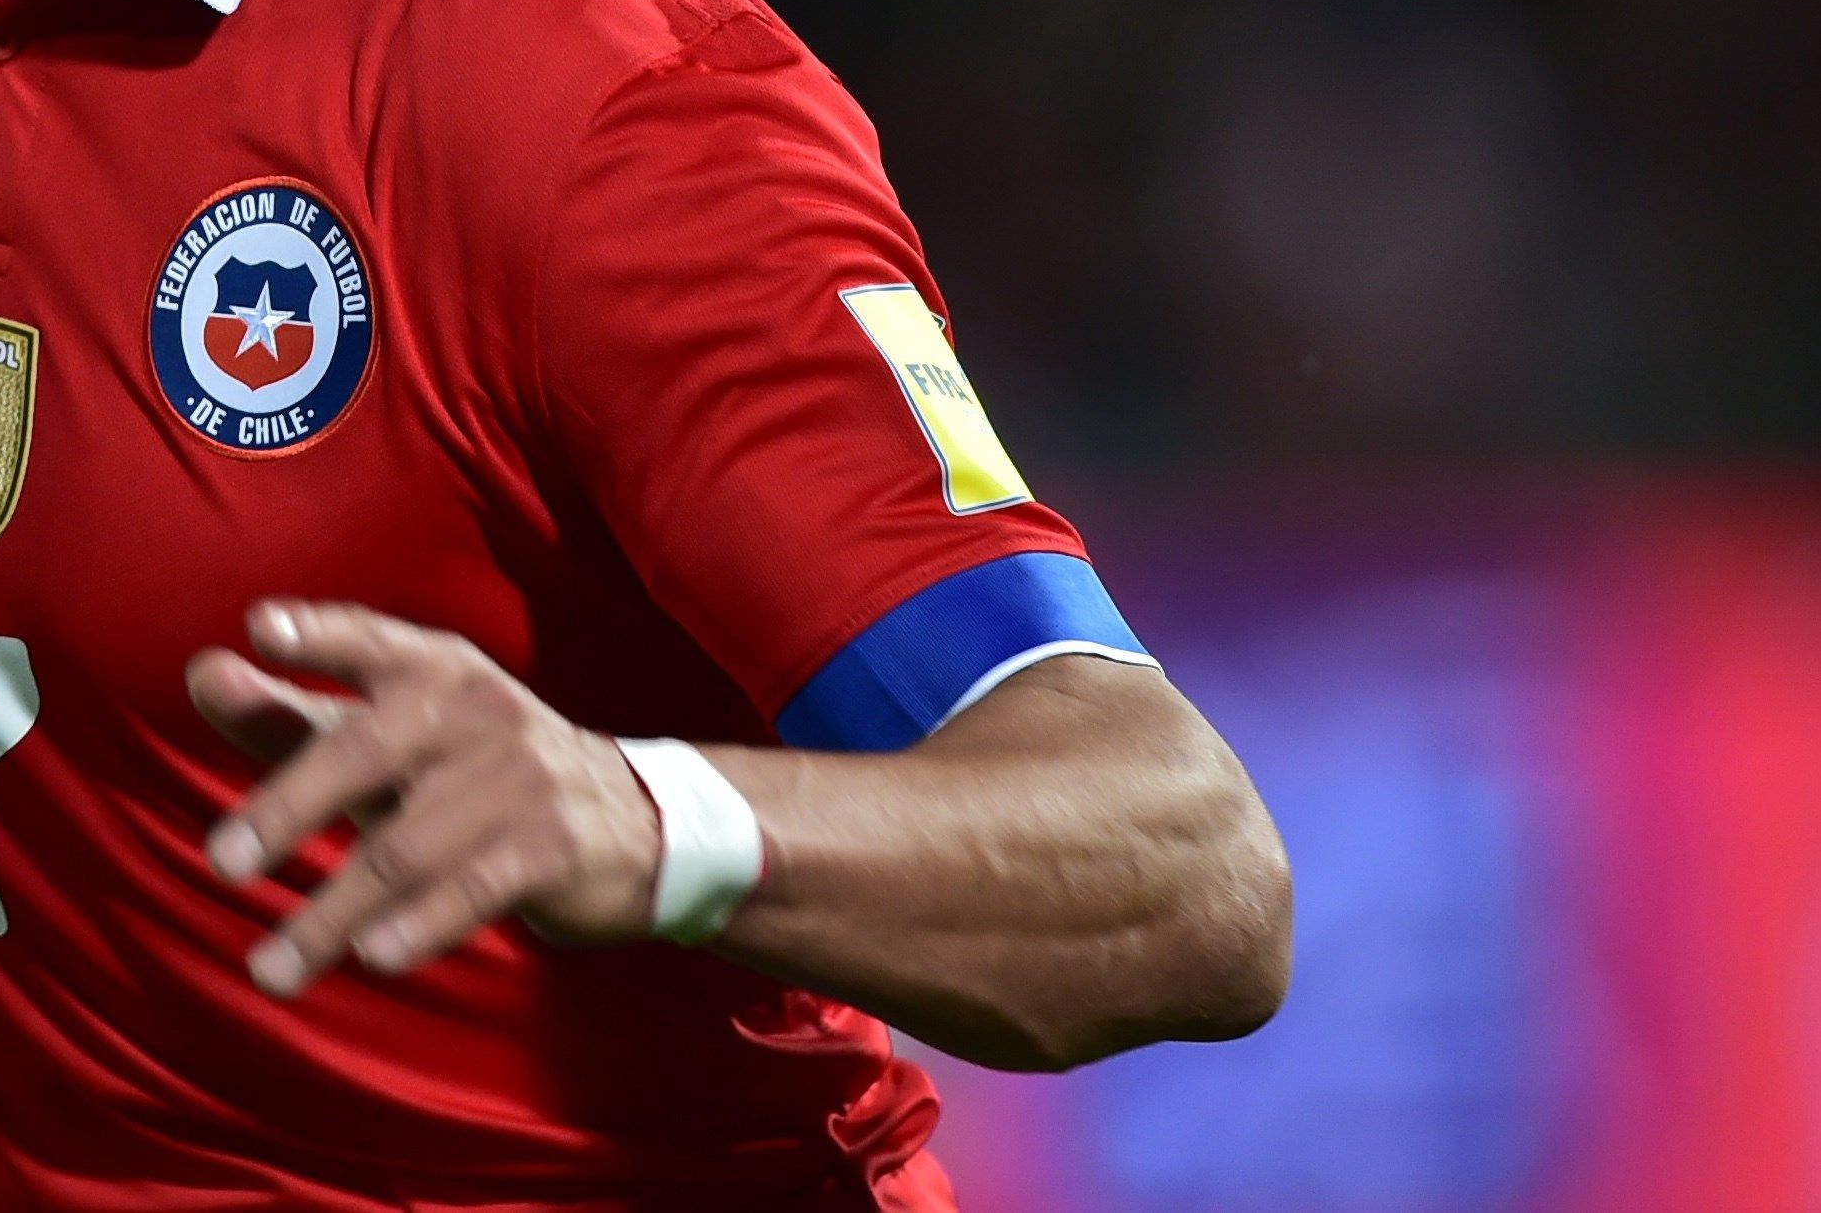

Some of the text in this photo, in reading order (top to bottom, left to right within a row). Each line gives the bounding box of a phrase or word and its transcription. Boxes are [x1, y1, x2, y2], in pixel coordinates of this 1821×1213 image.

[156, 192, 367, 329] FEDERACION DE FUTBOL
[191, 396, 309, 445] DE CHILE
